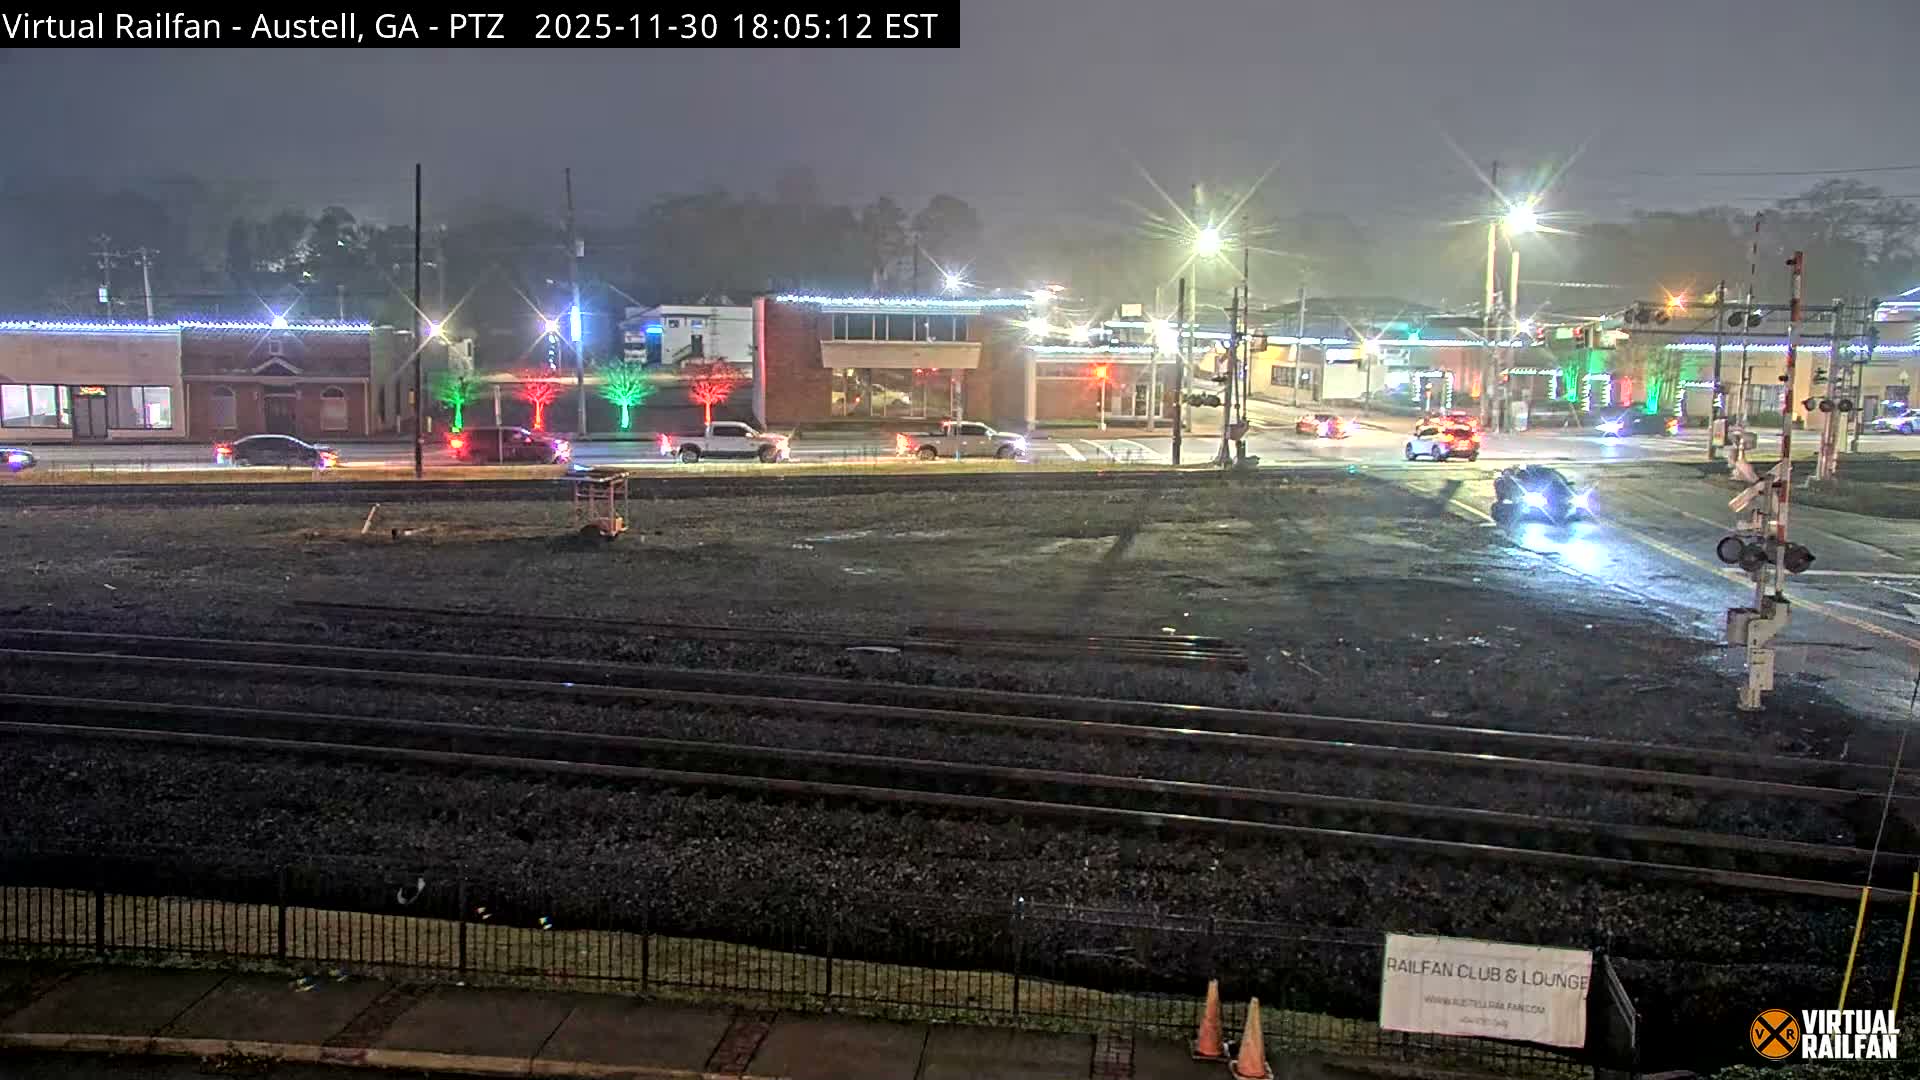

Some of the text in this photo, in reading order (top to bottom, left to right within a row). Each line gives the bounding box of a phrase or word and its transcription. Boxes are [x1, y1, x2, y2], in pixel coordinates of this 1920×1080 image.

[1387, 957, 1590, 991] RAILFAN CLUB & LOUNGE
